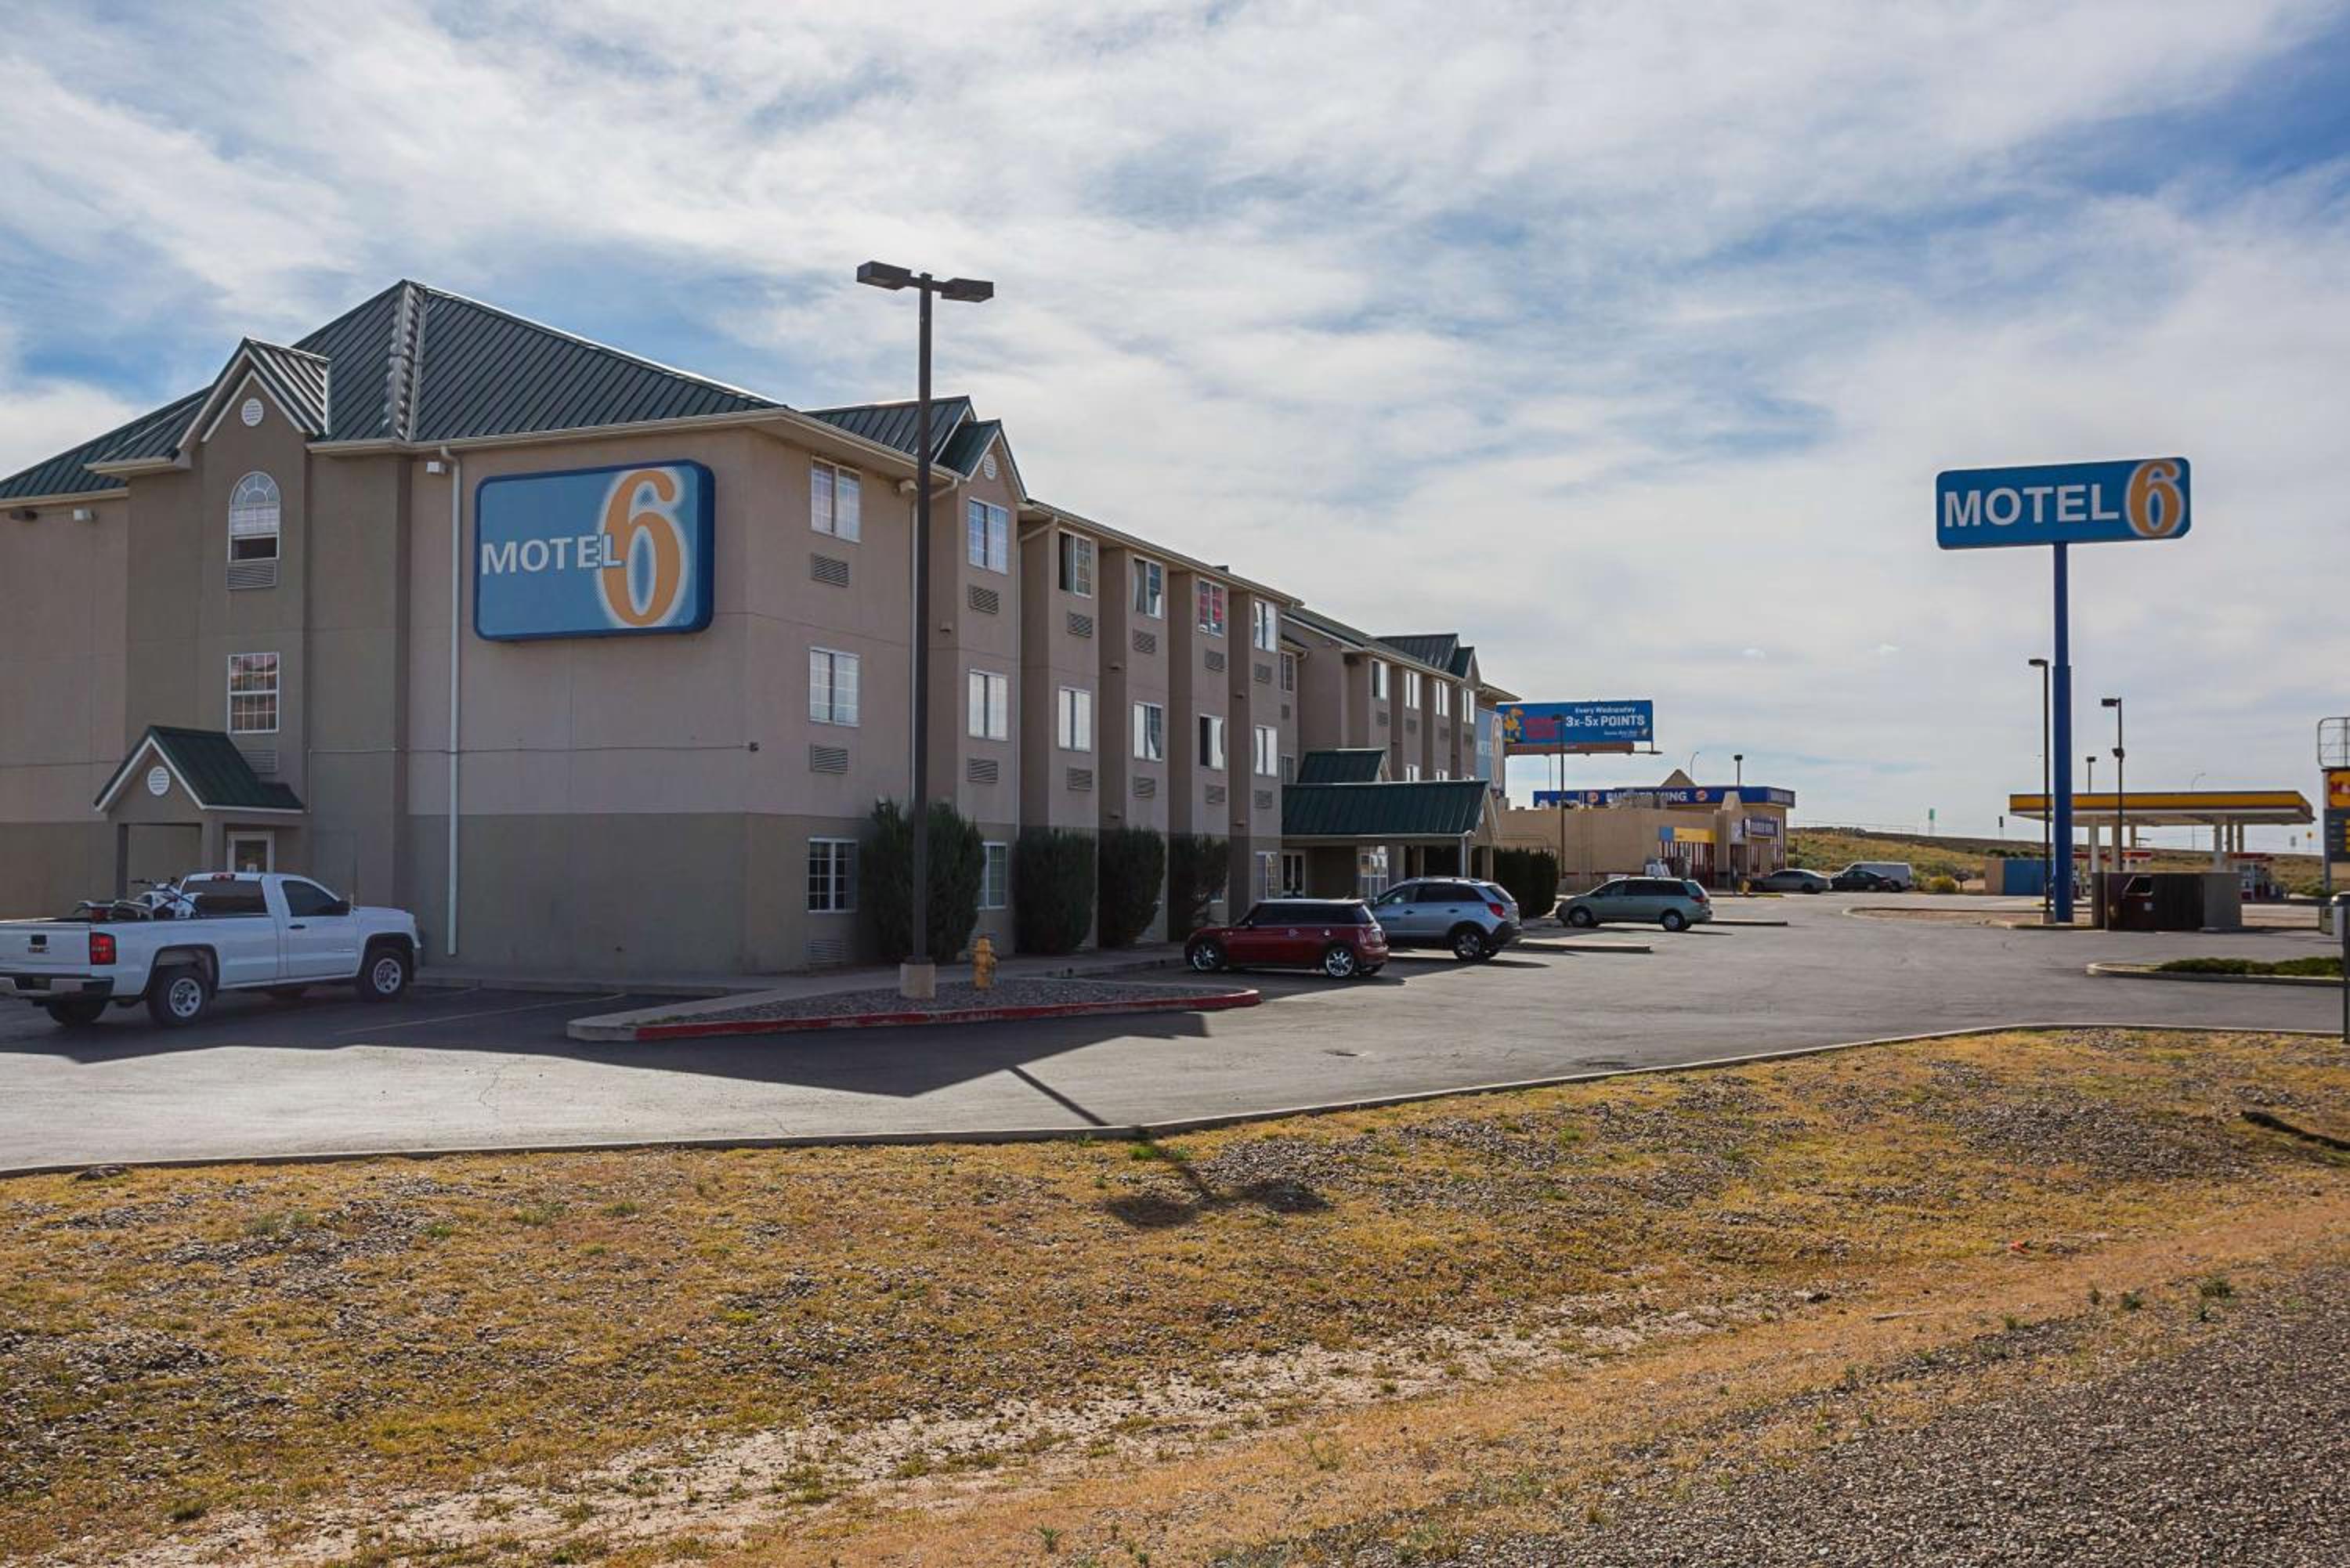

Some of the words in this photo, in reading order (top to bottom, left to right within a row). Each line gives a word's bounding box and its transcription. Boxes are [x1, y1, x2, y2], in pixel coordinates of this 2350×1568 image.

[1944, 483, 2120, 527] MOTEL
[2125, 458, 2186, 538] 6
[482, 534, 622, 576] MOTEL
[596, 467, 689, 629] 6
[1566, 715, 1599, 728] 3x-5x
[1600, 715, 1646, 726] POINTS
